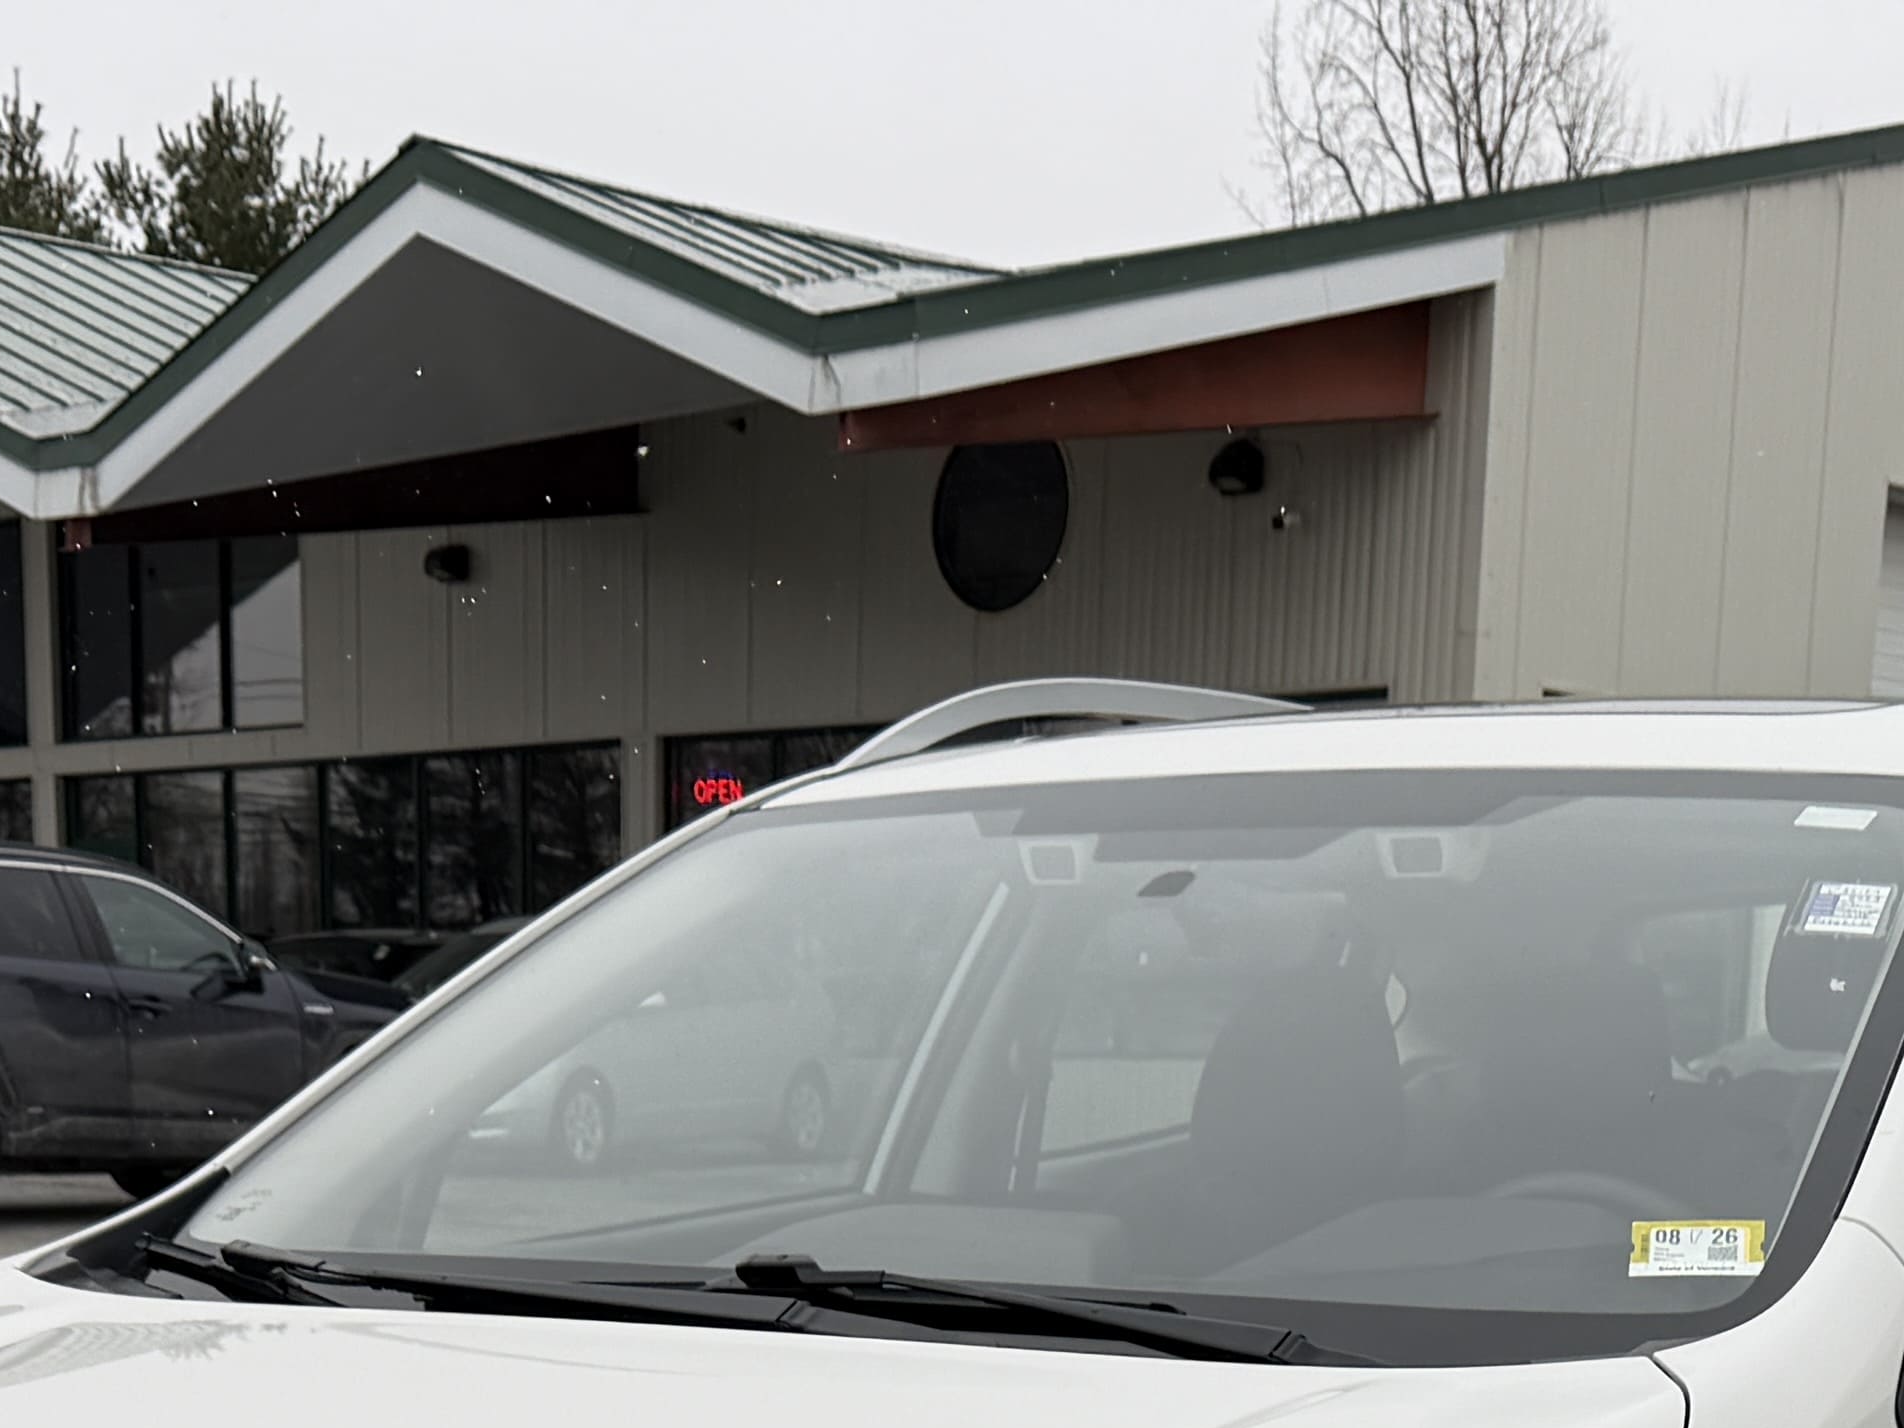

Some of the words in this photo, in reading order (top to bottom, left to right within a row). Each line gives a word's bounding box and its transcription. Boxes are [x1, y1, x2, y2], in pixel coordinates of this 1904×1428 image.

[694, 777, 744, 804] OPEN
[1655, 1228, 1681, 1245] 08
[1711, 1228, 1738, 1245] 26
